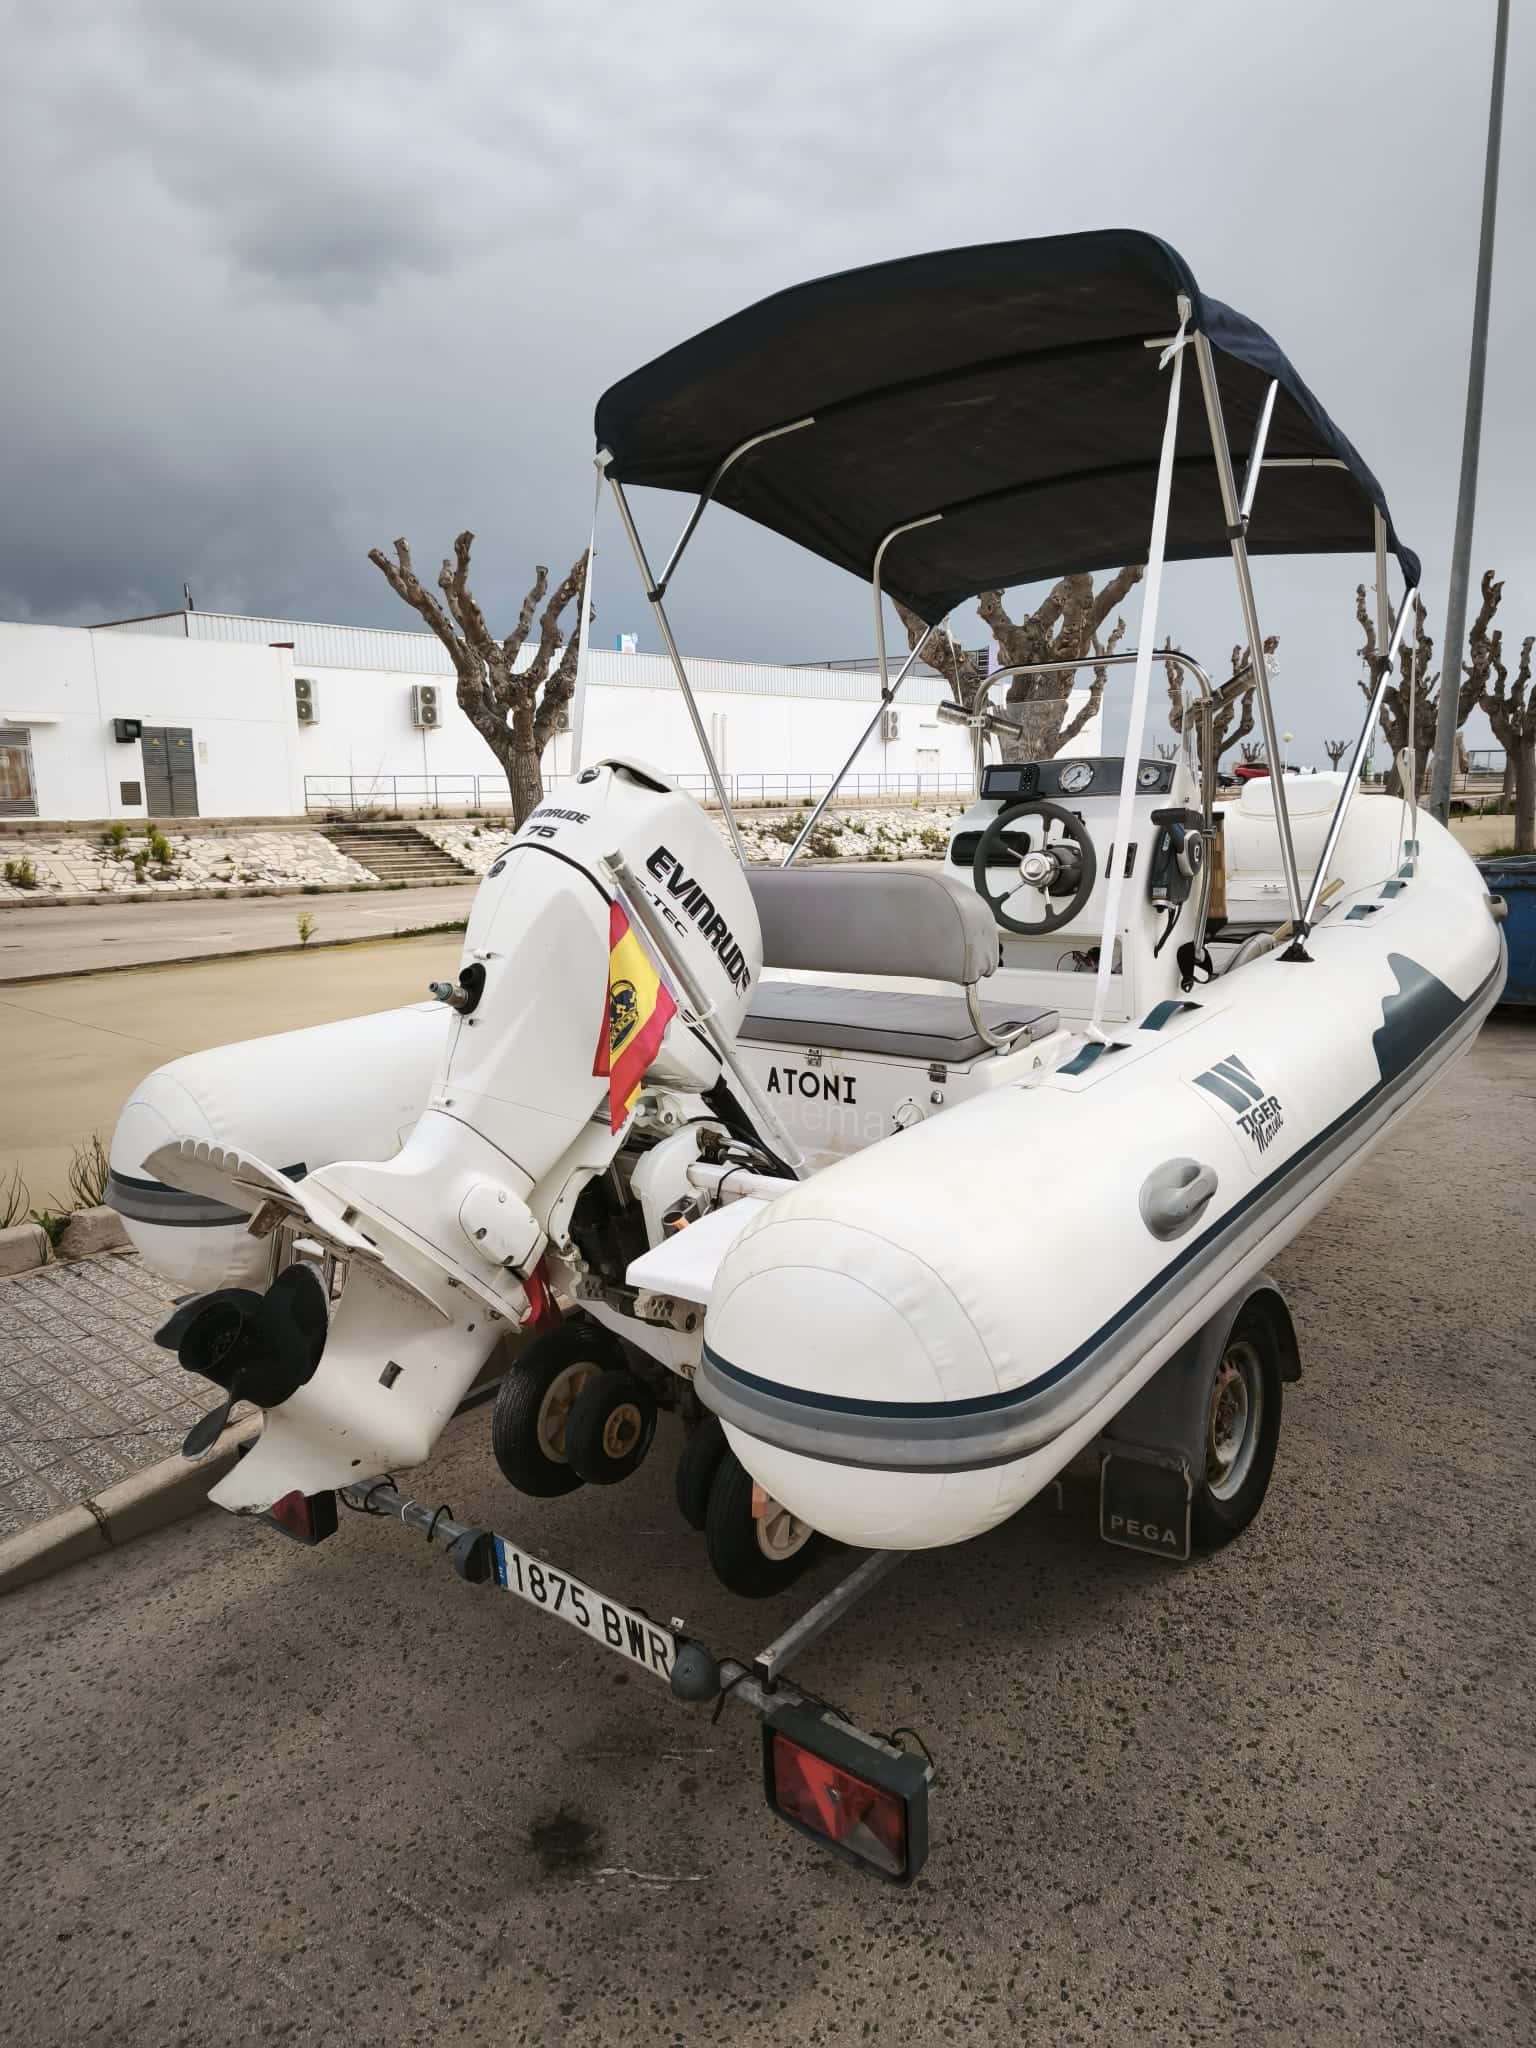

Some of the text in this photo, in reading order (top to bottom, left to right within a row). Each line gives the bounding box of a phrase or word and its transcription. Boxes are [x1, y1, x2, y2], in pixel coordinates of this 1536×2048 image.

[526, 825, 558, 839] 75
[767, 1066, 857, 1105] ATONI
[1236, 1095, 1283, 1135] TIGER
[1111, 1514, 1177, 1545] PEGA
[513, 1553, 672, 1678] 1875 BWR
